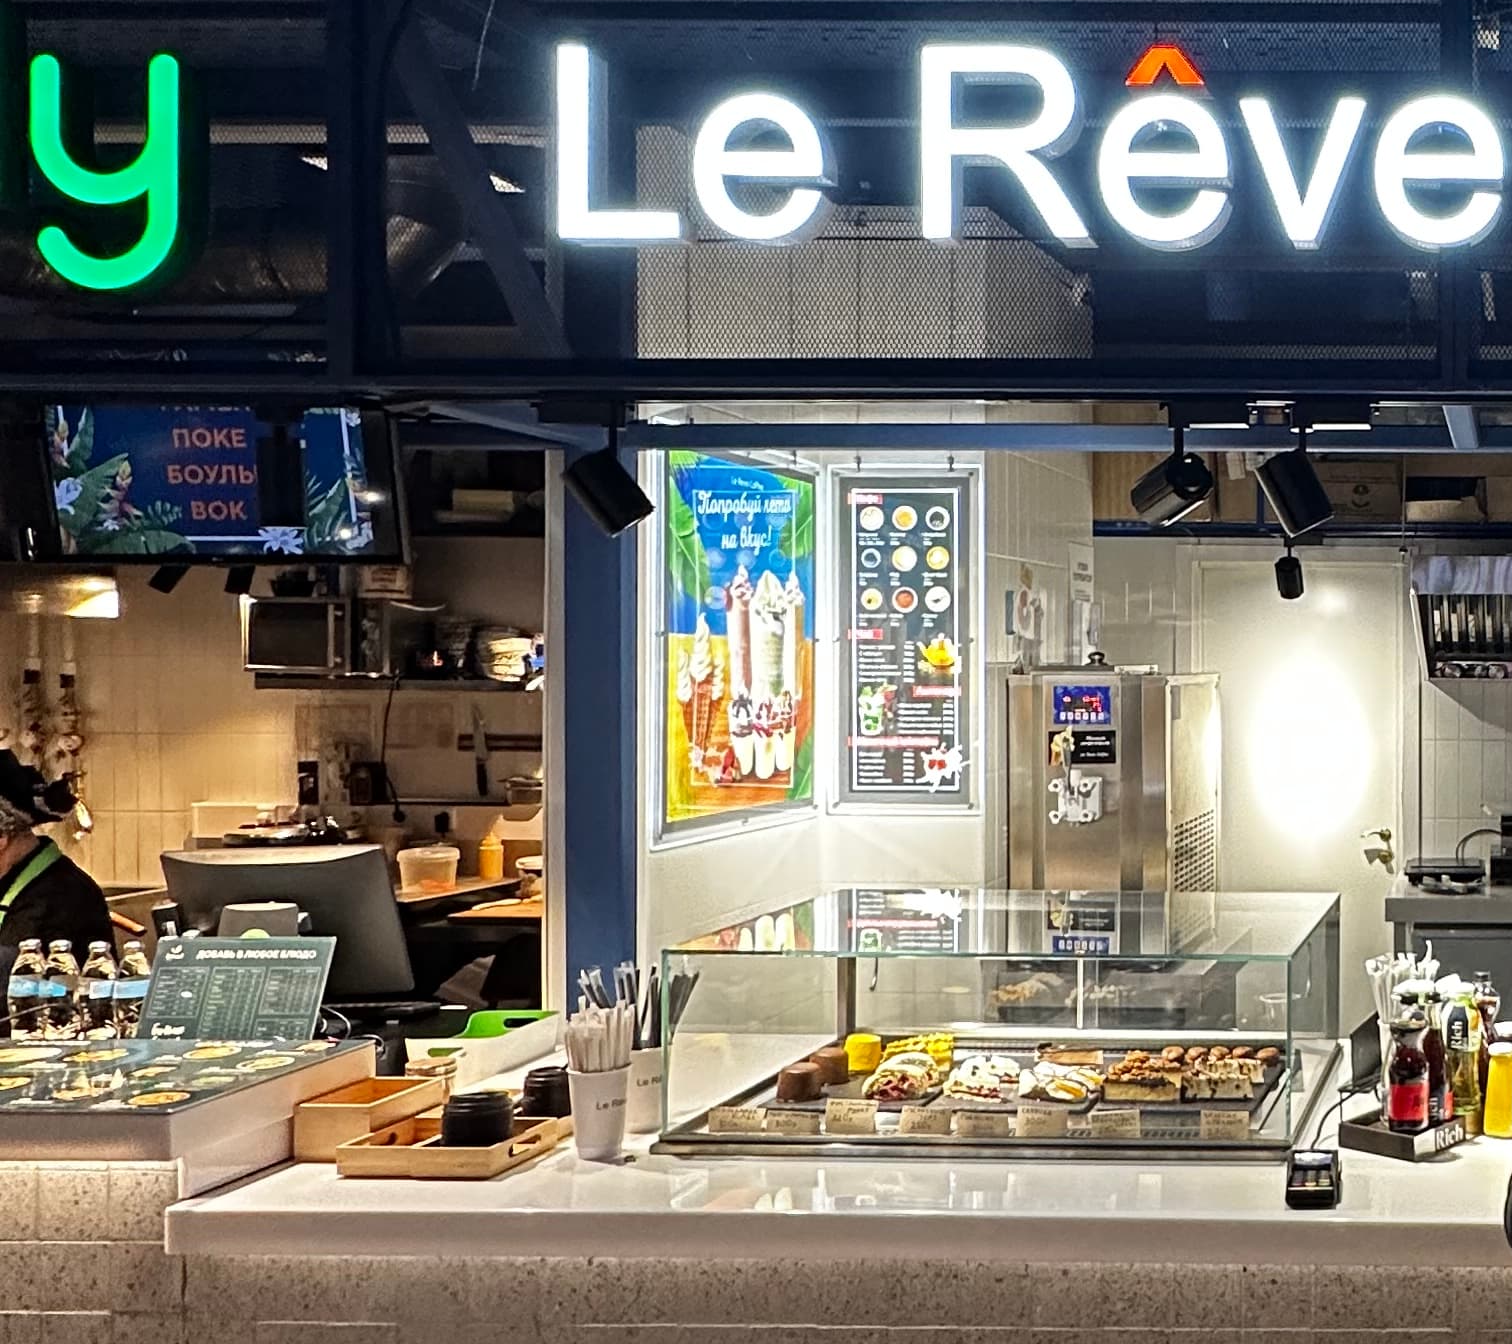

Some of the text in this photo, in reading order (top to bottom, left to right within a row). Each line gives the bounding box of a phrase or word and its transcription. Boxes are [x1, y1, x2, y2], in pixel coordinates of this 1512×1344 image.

[556, 43, 828, 244] Le
[920, 43, 1506, 250] Rêve
[172, 427, 248, 449] ПОКЕ
[191, 500, 248, 521] ВОК
[697, 490, 761, 522] Попробуй
[721, 533, 738, 549] на
[1451, 1021, 1463, 1049] Rich
[1435, 1124, 1464, 1151] Rich
